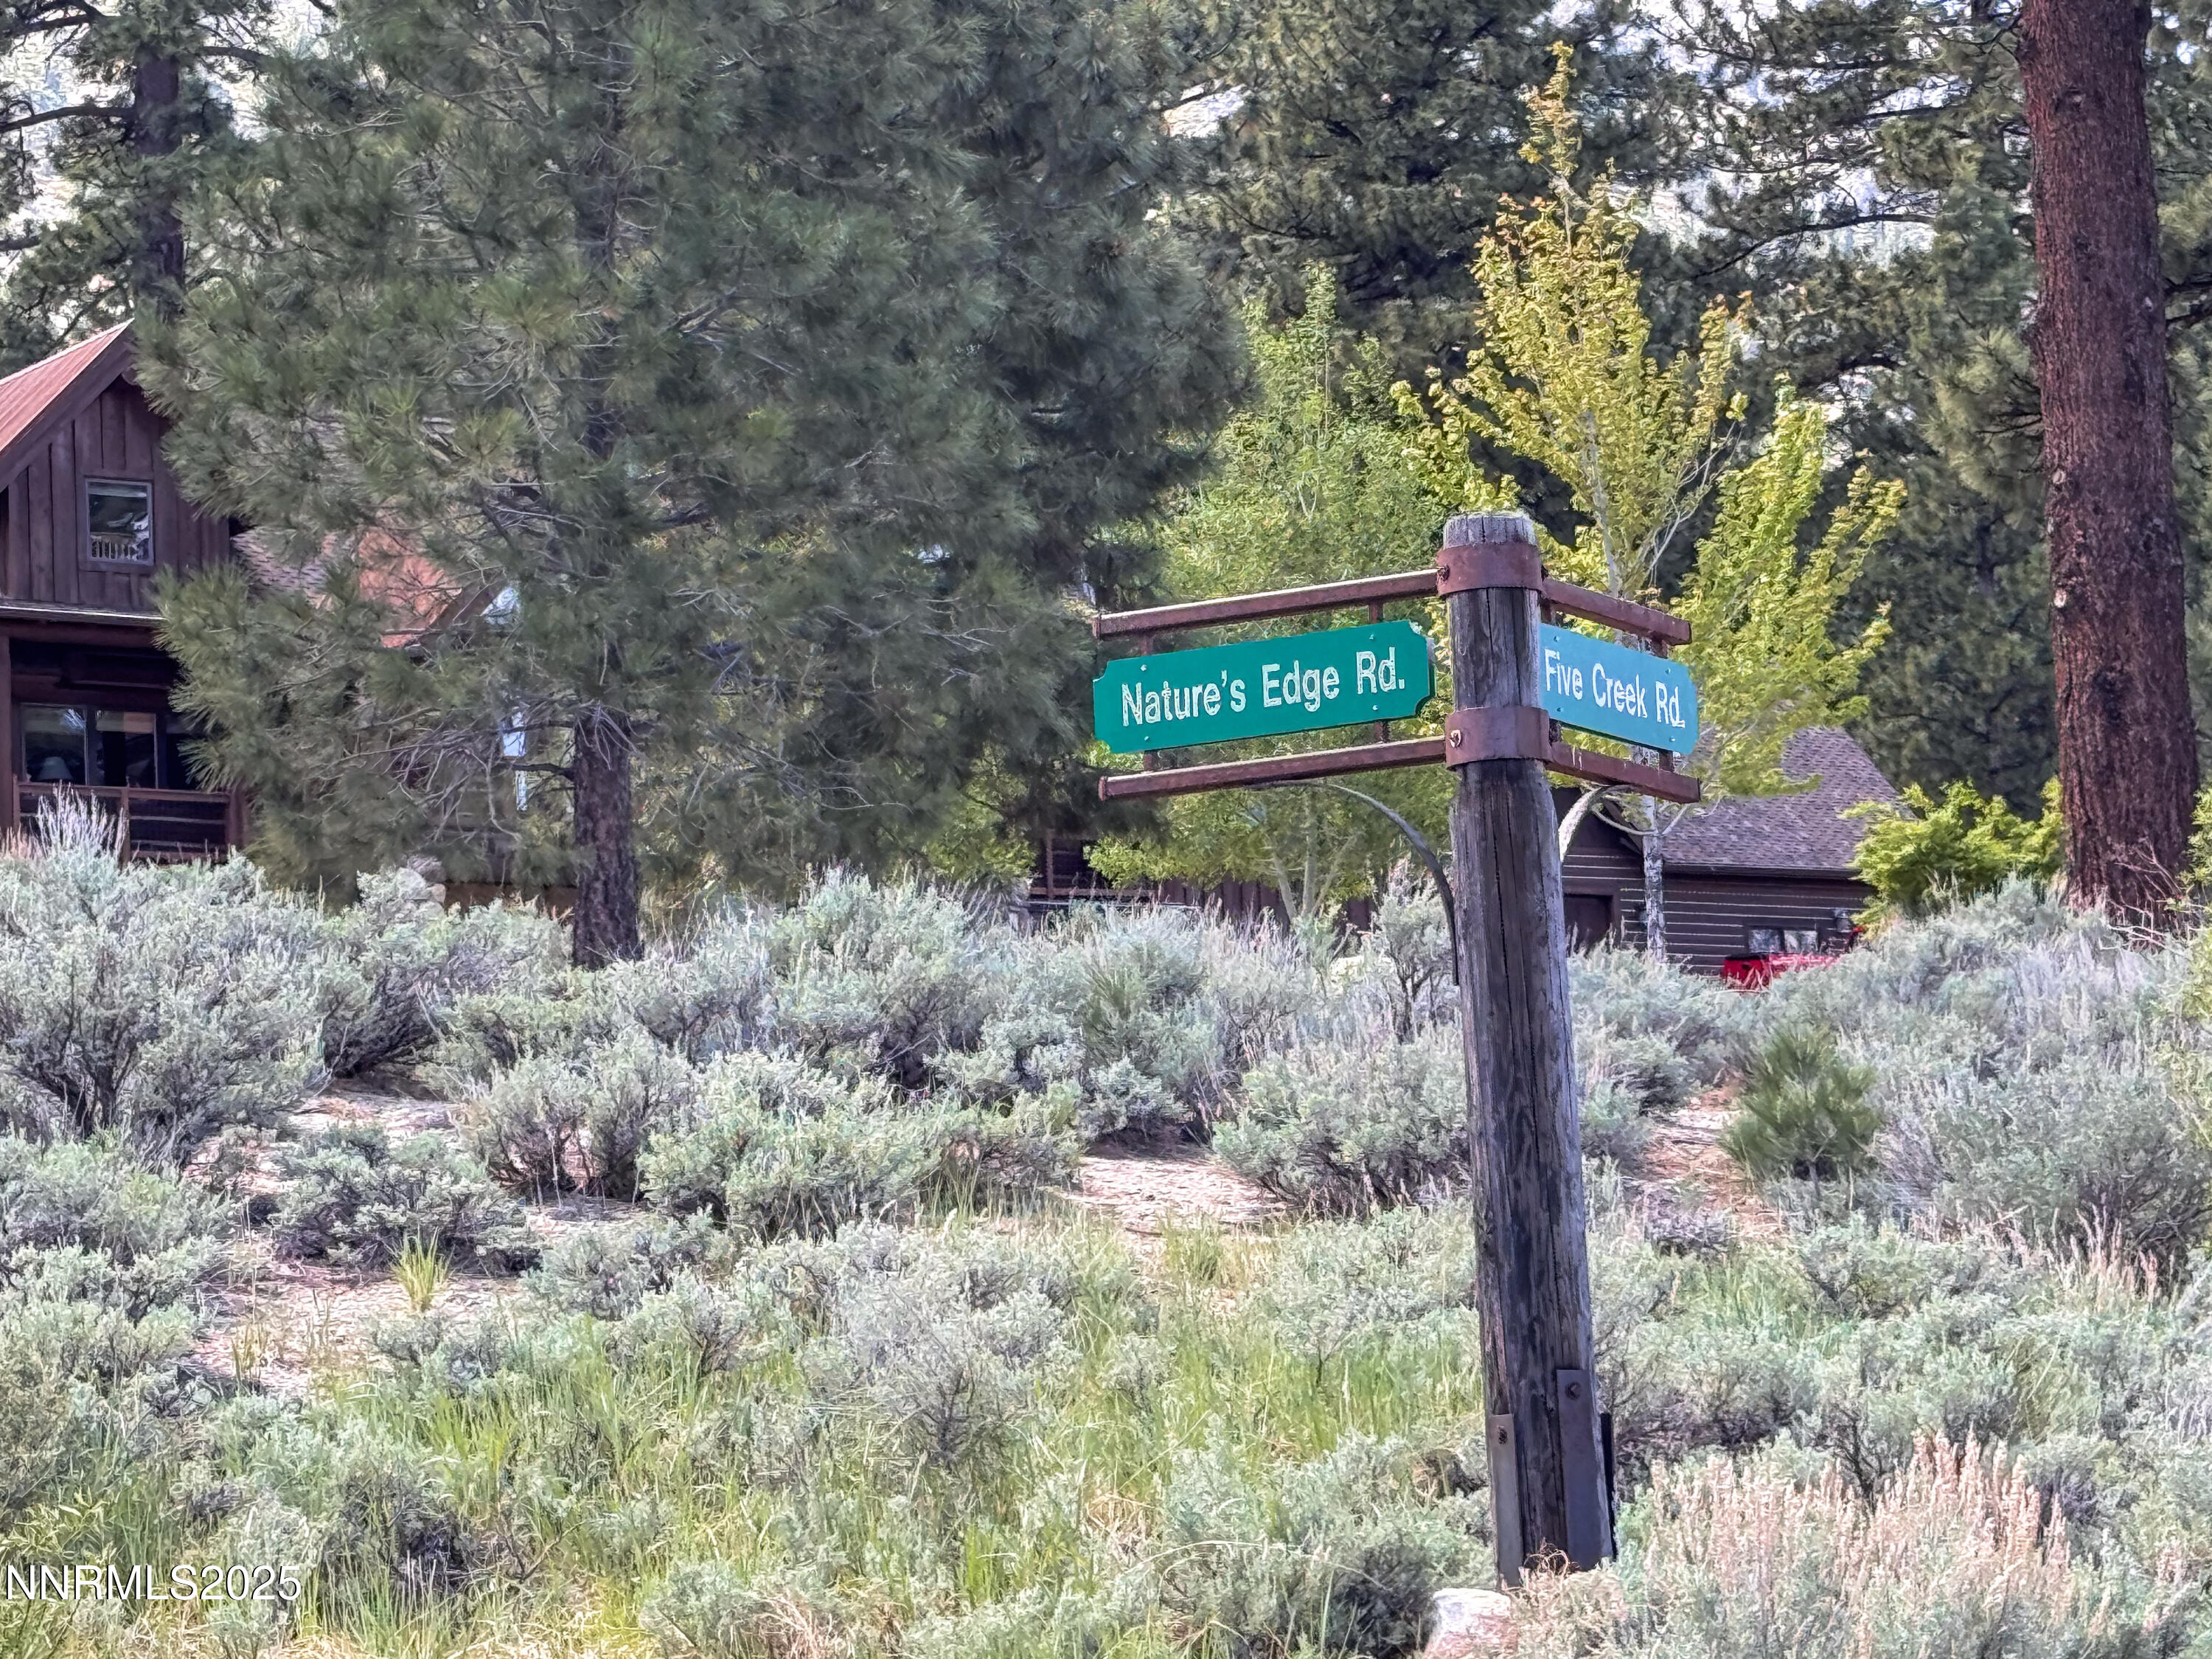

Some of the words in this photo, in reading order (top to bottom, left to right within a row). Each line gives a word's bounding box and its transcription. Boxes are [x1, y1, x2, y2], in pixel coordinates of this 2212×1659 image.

[1121, 669, 1246, 727] Nature's
[1262, 660, 1340, 712] Edge
[1355, 647, 1405, 695] Rd.
[1544, 648, 1584, 700] Five
[1592, 663, 1648, 719] Creek
